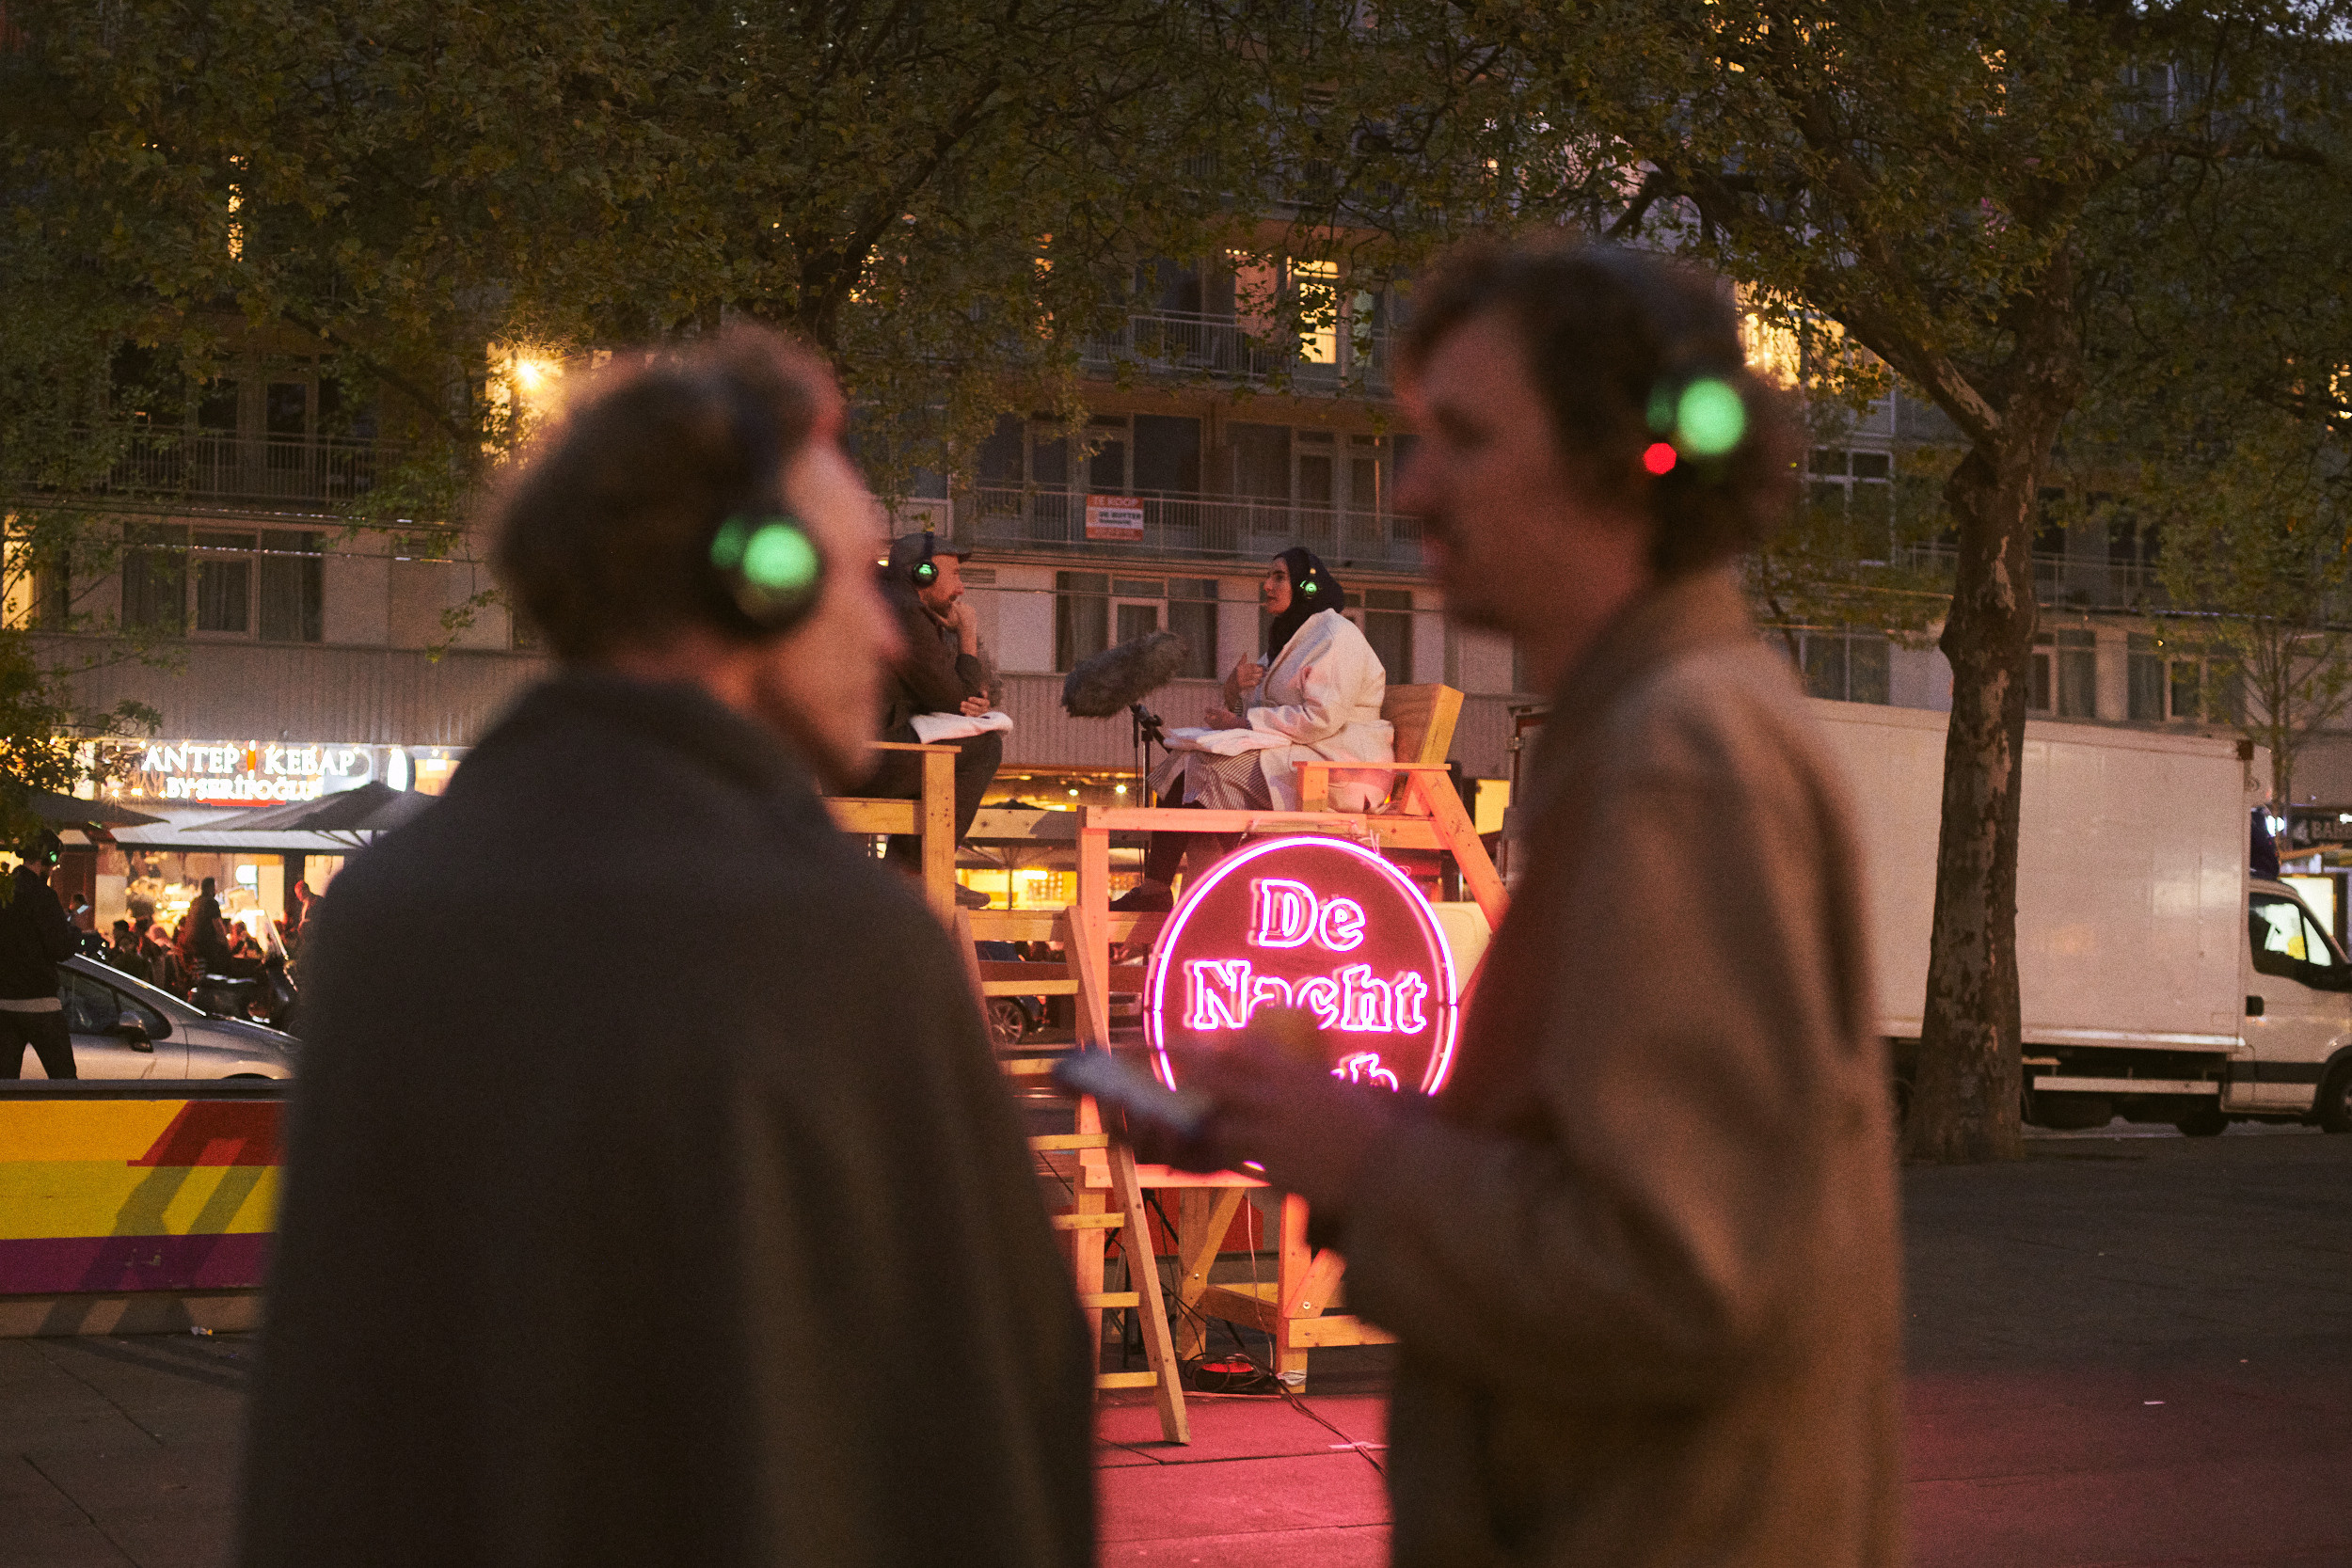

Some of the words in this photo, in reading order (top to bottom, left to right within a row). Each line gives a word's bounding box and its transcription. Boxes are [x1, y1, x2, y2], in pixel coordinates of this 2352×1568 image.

[141, 744, 241, 774] ANTEP
[263, 745, 357, 776] KEBAP
[1258, 879, 1366, 951] De
